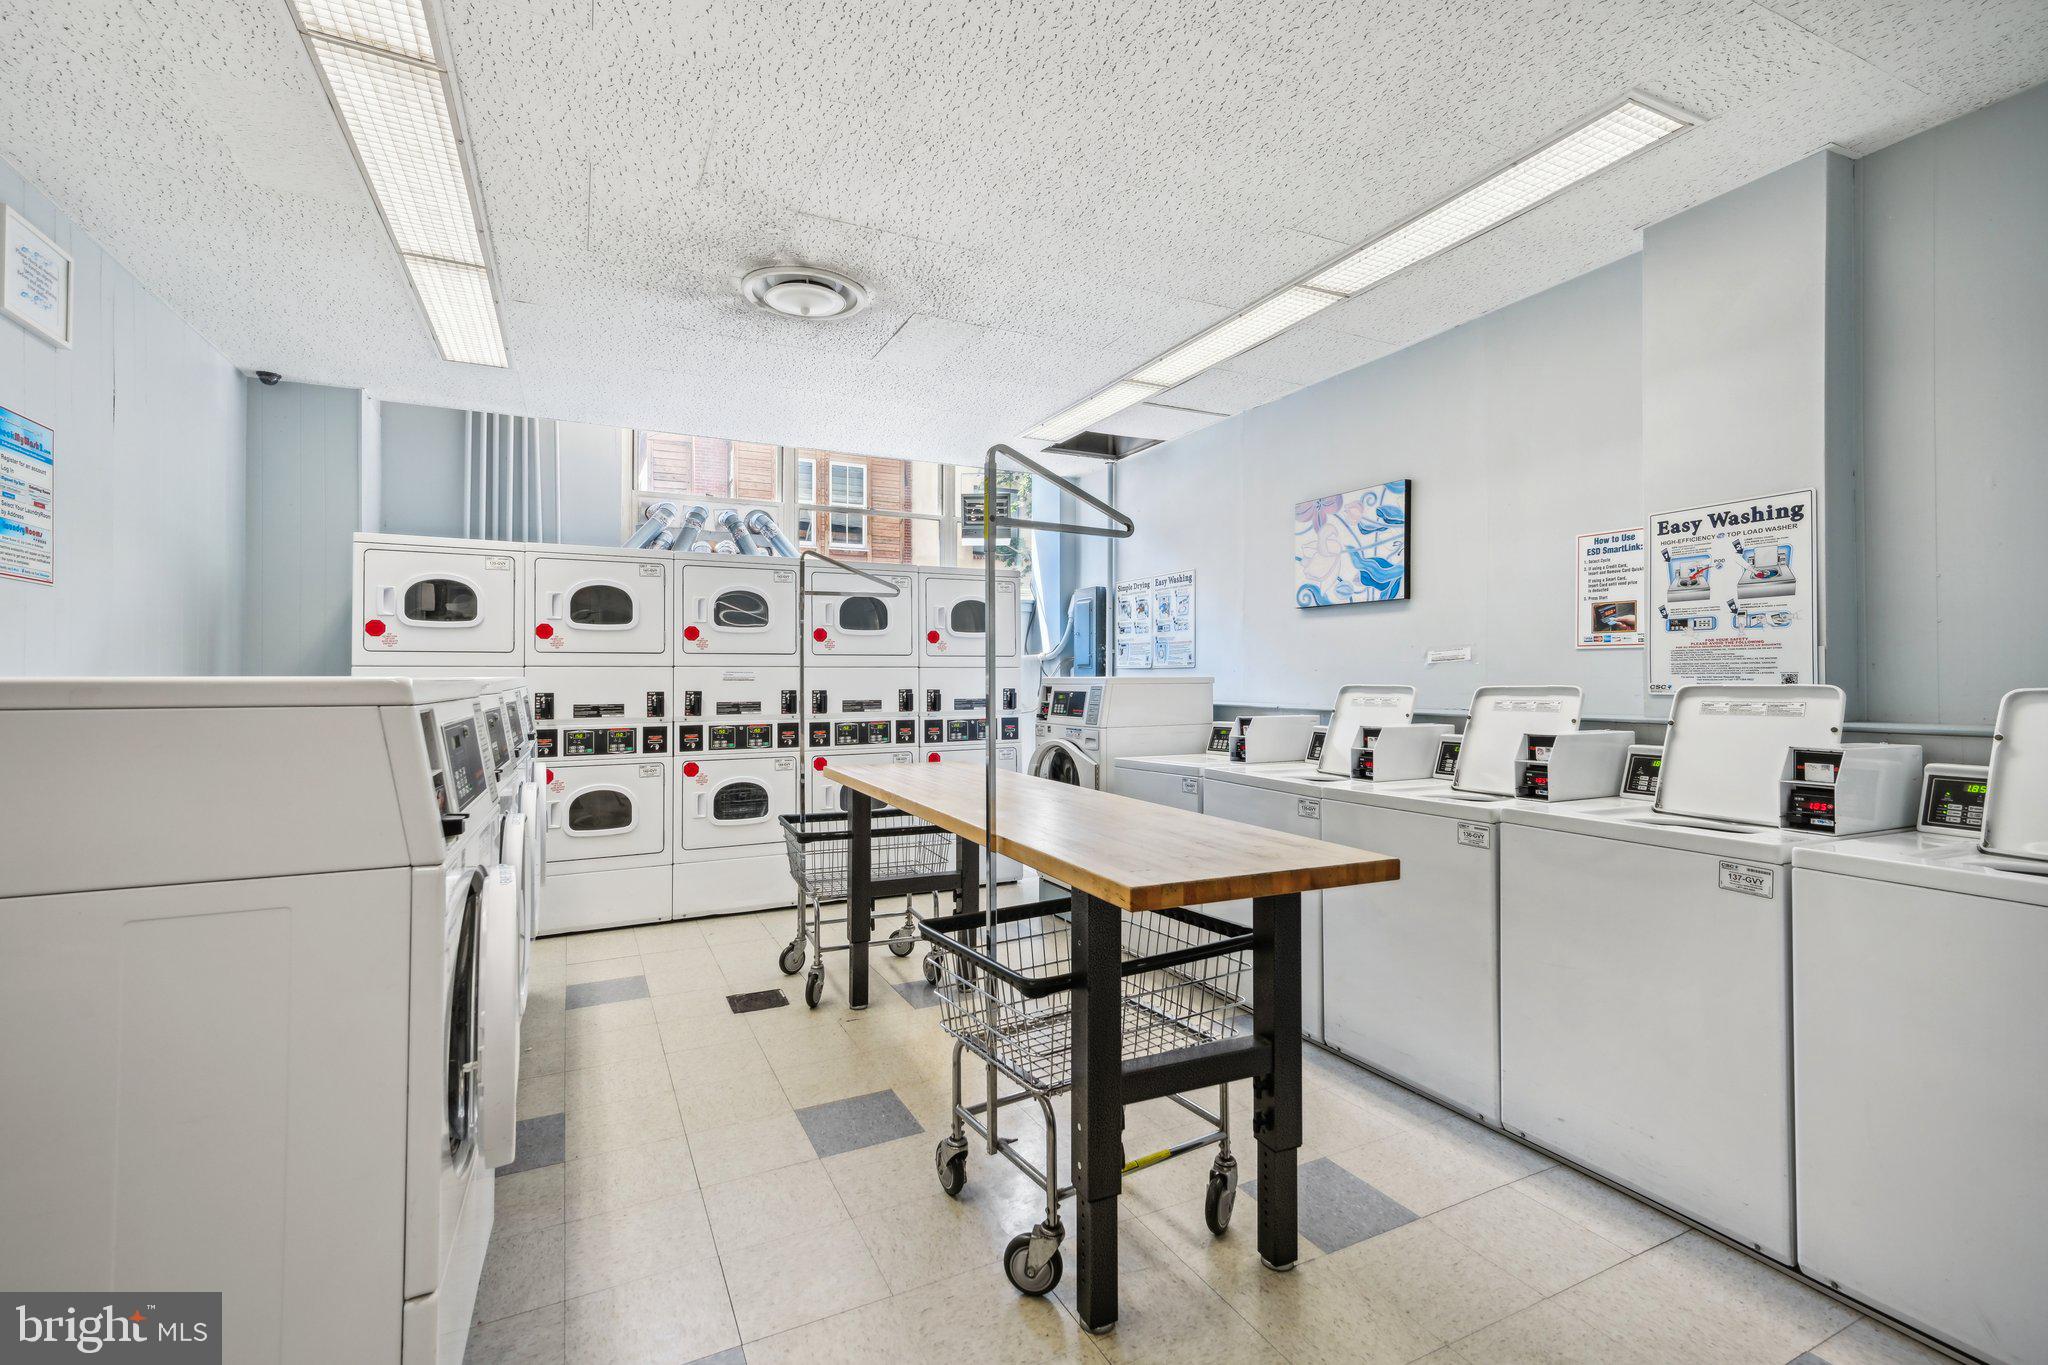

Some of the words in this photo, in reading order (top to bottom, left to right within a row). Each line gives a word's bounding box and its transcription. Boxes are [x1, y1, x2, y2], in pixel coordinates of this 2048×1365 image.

[1657, 518, 1702, 536] Easy
[1706, 504, 1805, 530] Washing
[1660, 534, 1716, 546] HIGH-EFFICIENCY
[1742, 526, 1764, 536] LOAD
[1765, 523, 1798, 533] WASHER
[1587, 548, 1600, 556] ESD
[1602, 543, 1643, 554] SmartLink:
[1155, 578, 1167, 587] Easy
[1168, 574, 1193, 584] Washing
[1118, 584, 1133, 593] Simple
[1134, 582, 1150, 590] Drying
[1729, 873, 1764, 885] 137-GVY
